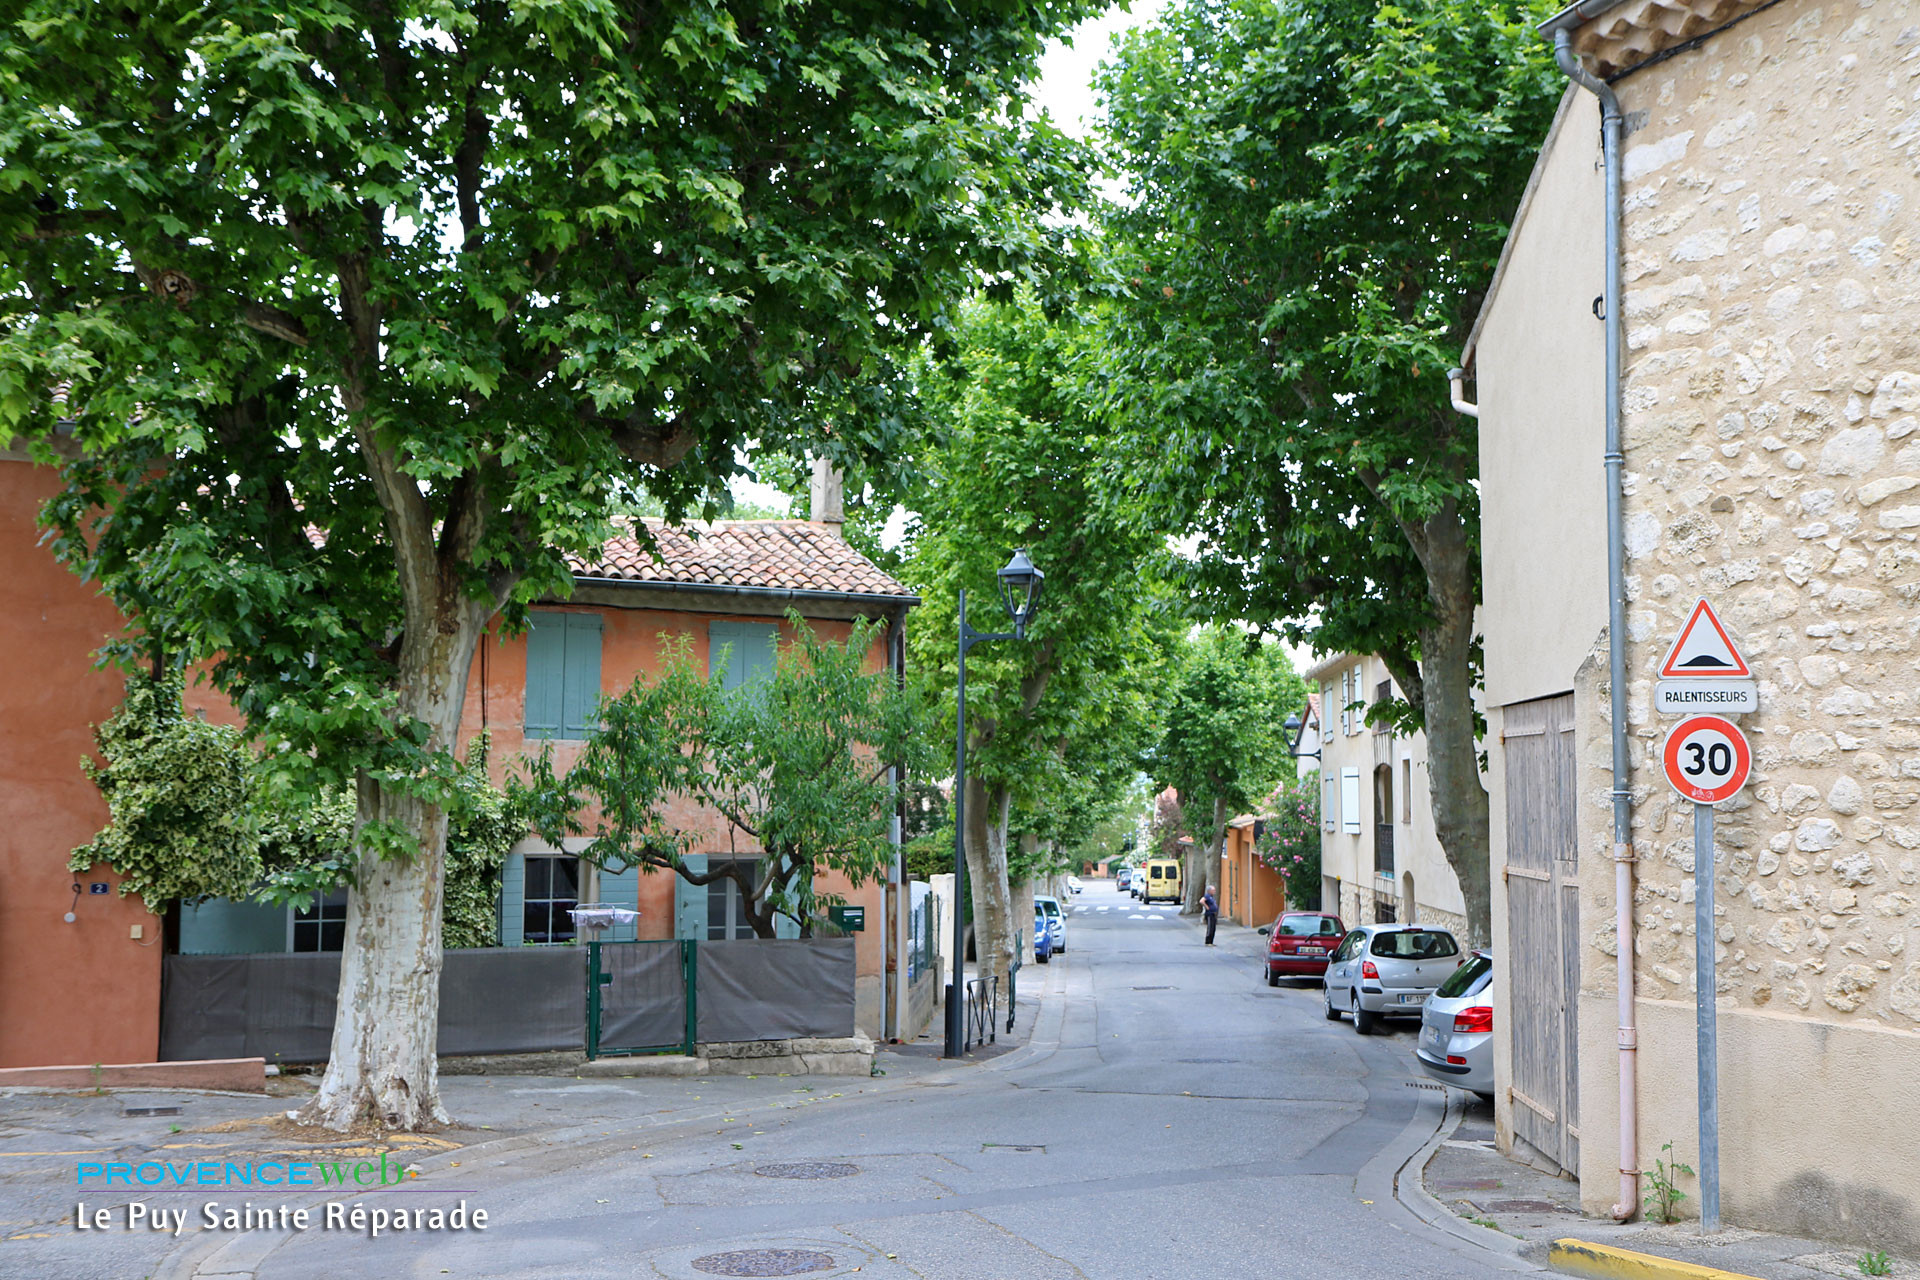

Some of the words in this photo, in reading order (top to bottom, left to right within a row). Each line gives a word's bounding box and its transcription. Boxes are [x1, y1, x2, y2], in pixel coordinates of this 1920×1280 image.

[1665, 691, 1748, 702] RALENTISSEURS
[1684, 742, 1732, 776] 30
[96, 884, 103, 893] 2
